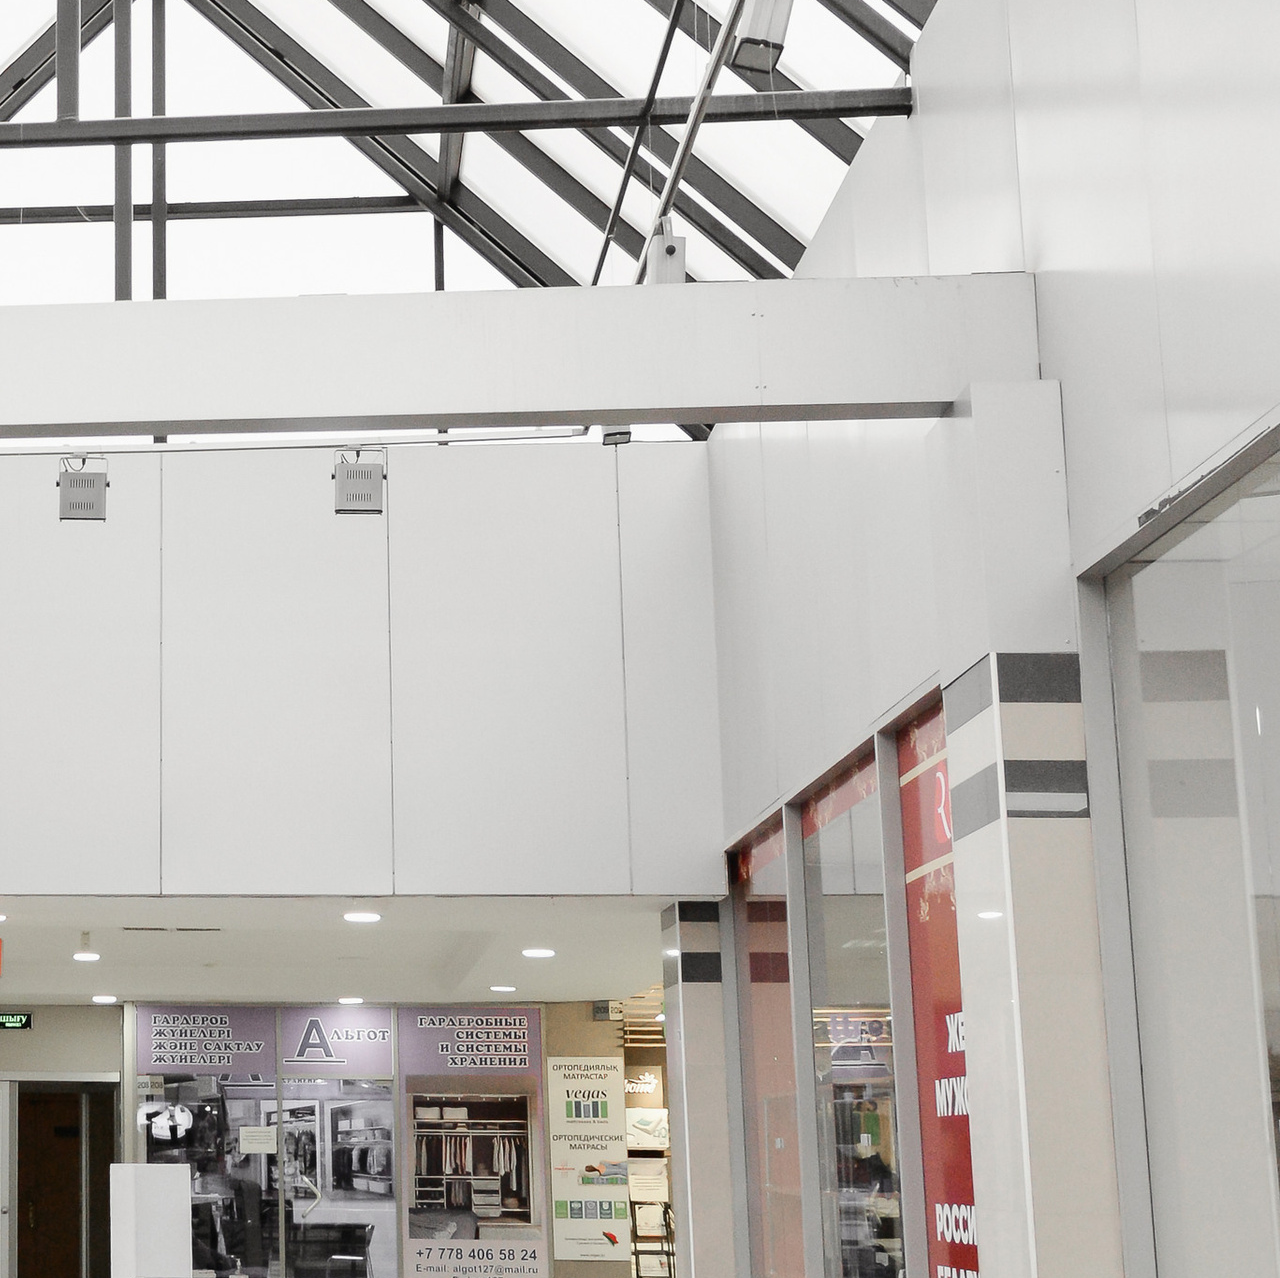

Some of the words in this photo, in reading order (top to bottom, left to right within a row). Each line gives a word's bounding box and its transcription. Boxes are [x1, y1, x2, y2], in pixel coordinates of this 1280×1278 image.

[152, 1015, 229, 1026] ГАРДЕРОБ
[418, 1017, 527, 1027] ГАРДЕРОБНЫЕ
[455, 1030, 527, 1040] СИСТЕМЫ
[152, 1041, 198, 1051] ЖӘНЕ
[203, 1041, 264, 1053] САҚТАУ
[439, 1043, 450, 1053] И
[456, 1043, 527, 1053] СИСТЕМЫ
[449, 1056, 528, 1066] ХРАНЕНИЯ
[552, 1064, 619, 1073] ОРТОПЕДИЯЛЫҚ
[565, 1089, 608, 1102] vegas
[552, 1134, 624, 1142] ОРТОПЕДИЧЕСКИЕ
[416, 1248, 433, 1260] +7
[438, 1248, 463, 1260] 778
[468, 1248, 494, 1261] 406
[499, 1249, 516, 1261] 58
[520, 1249, 538, 1261] 24
[415, 1263, 450, 1273] E-mail:
[452, 1264, 539, 1275] algot127@mail.ru
